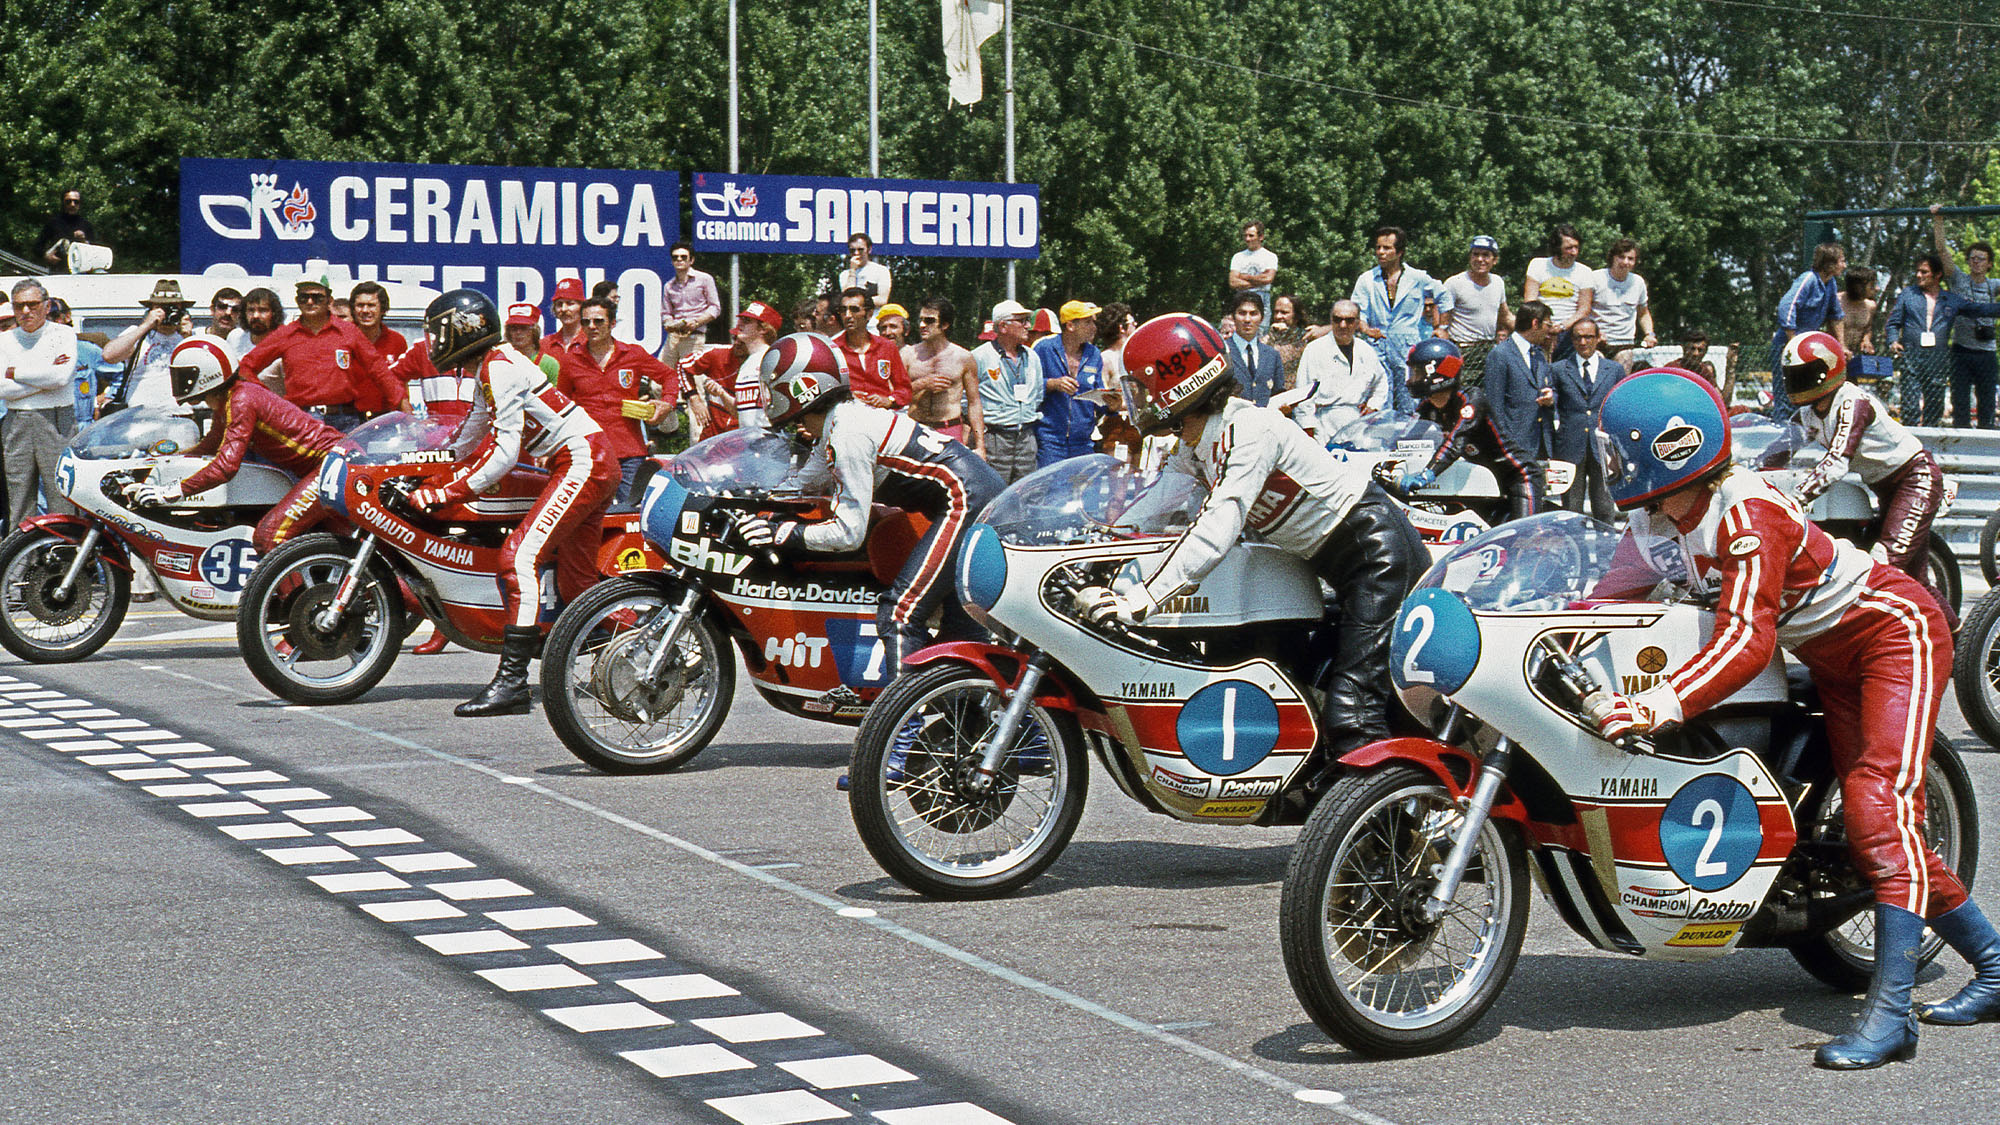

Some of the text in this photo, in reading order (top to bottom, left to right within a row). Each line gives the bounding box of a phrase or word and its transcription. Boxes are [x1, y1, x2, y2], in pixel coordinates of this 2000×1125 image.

[329, 175, 666, 246] CERAMICA
[785, 187, 1038, 248] SANTERNO
[696, 220, 780, 242] CERAMICA
[798, 385, 820, 404] agv
[1172, 365, 1219, 400] Marlboro
[401, 450, 454, 463] MOTUL
[321, 457, 344, 501] 4
[285, 475, 321, 520] PALOM
[535, 478, 580, 535] FURYGAN
[640, 474, 671, 533] 7
[356, 501, 474, 566] SONAUTO YAMAHA
[209, 545, 258, 587] 35
[670, 536, 753, 575] Bhv
[733, 577, 882, 605] Harley-Davids
[859, 623, 886, 681] 7
[1402, 604, 1436, 684] 2
[1121, 682, 1176, 698] YAMAHA
[1621, 674, 1672, 696] YAMA
[1222, 687, 1237, 761] 1
[1156, 775, 1205, 794] CHAMPION
[1220, 779, 1281, 797] Castrol
[1600, 777, 1659, 797] YAMAHA
[1203, 805, 1257, 813] DUNLOP
[1691, 798, 1728, 878] 2
[1623, 893, 1687, 911] CHAMPION
[1687, 898, 1757, 920] Castrol
[1678, 930, 1734, 941] DUNLOP
